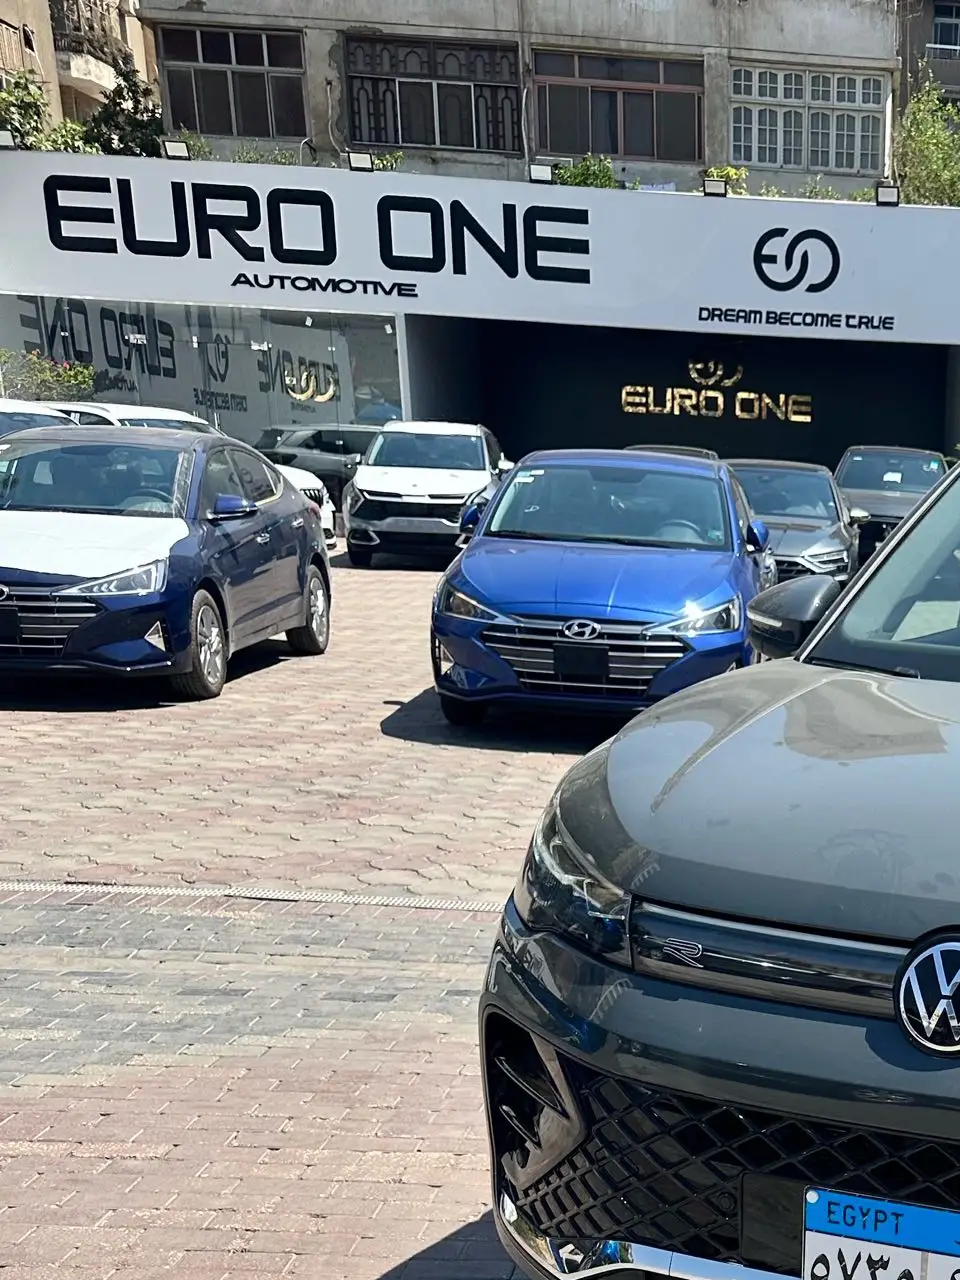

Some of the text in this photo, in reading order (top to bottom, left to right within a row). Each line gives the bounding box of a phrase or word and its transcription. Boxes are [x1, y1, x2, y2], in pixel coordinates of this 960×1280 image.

[43, 174, 591, 284] EURO ONE
[231, 272, 418, 298] AUTOMOTIVE
[698, 307, 763, 325] DREAM
[765, 311, 842, 329] BECOME
[621, 385, 812, 423] EURO ONE
[826, 1201, 905, 1236] EGYPT
